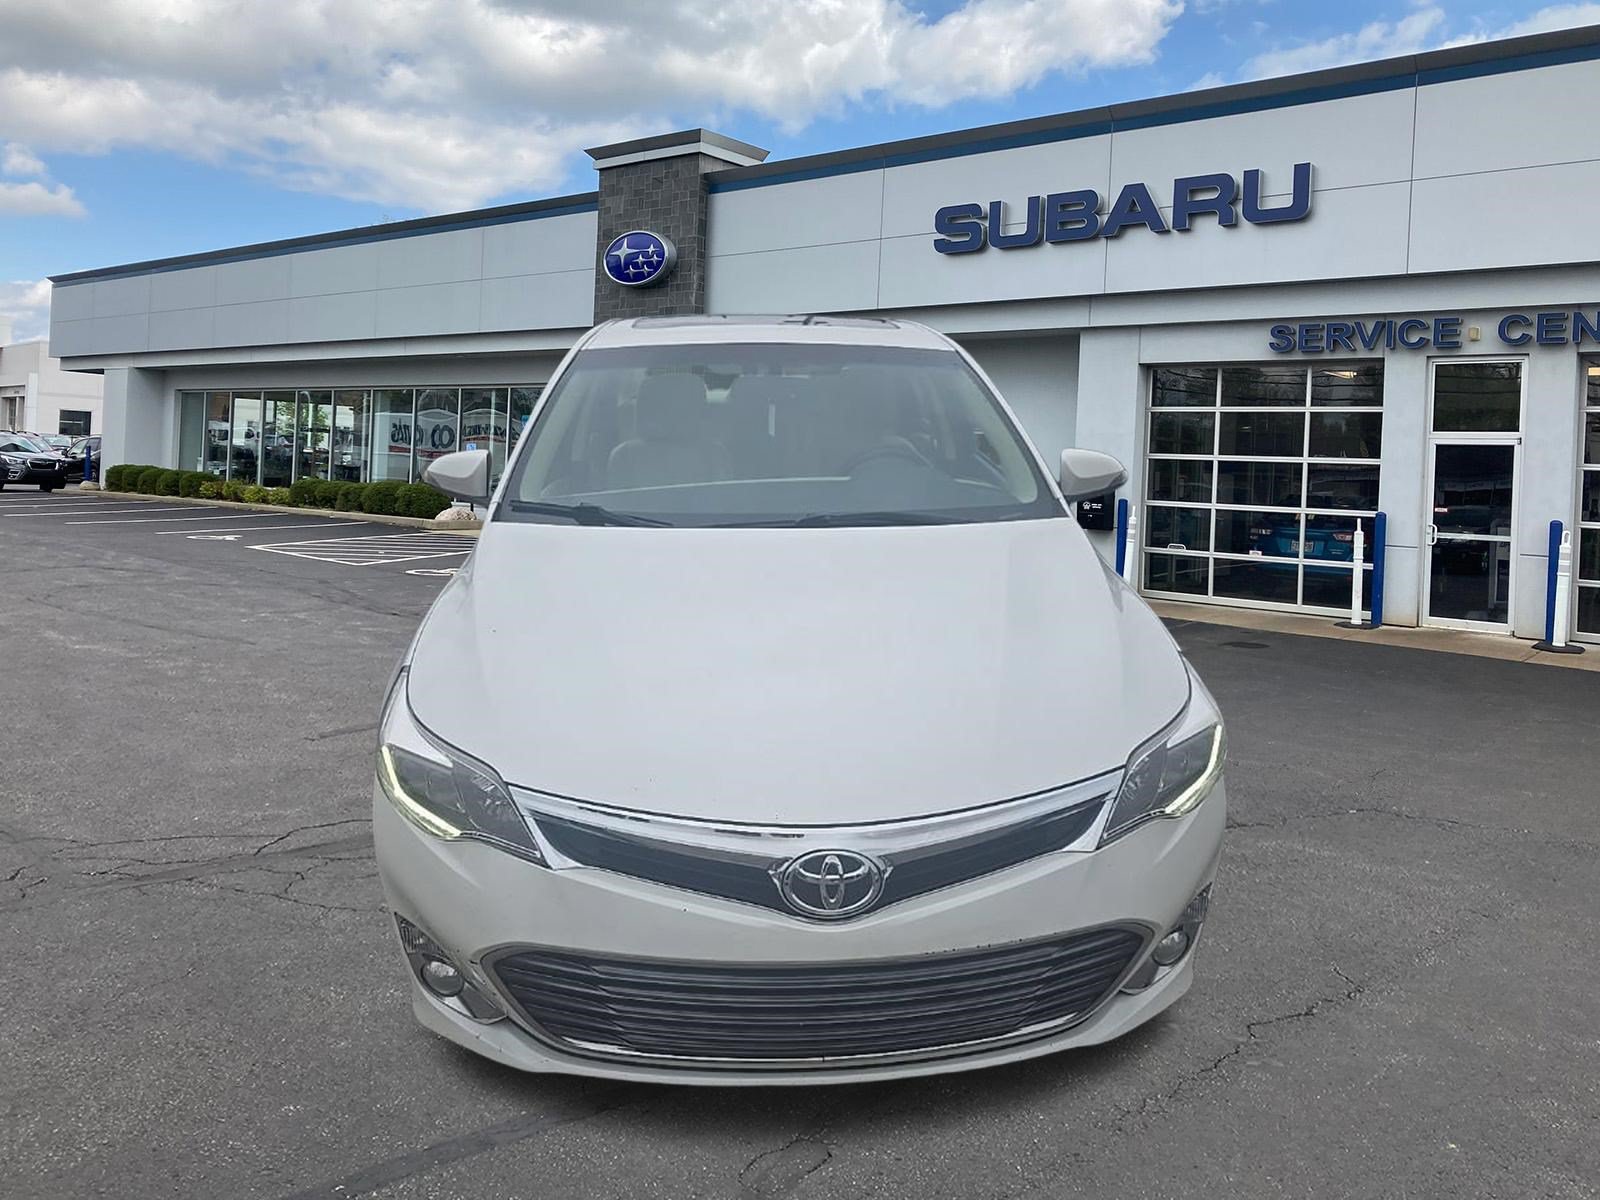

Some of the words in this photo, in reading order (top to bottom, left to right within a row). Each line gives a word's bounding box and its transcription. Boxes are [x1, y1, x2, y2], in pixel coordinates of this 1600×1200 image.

[934, 162, 1313, 255] SUBARU
[1269, 317, 1463, 353] SERVICE
[1498, 311, 1600, 346] CEN
